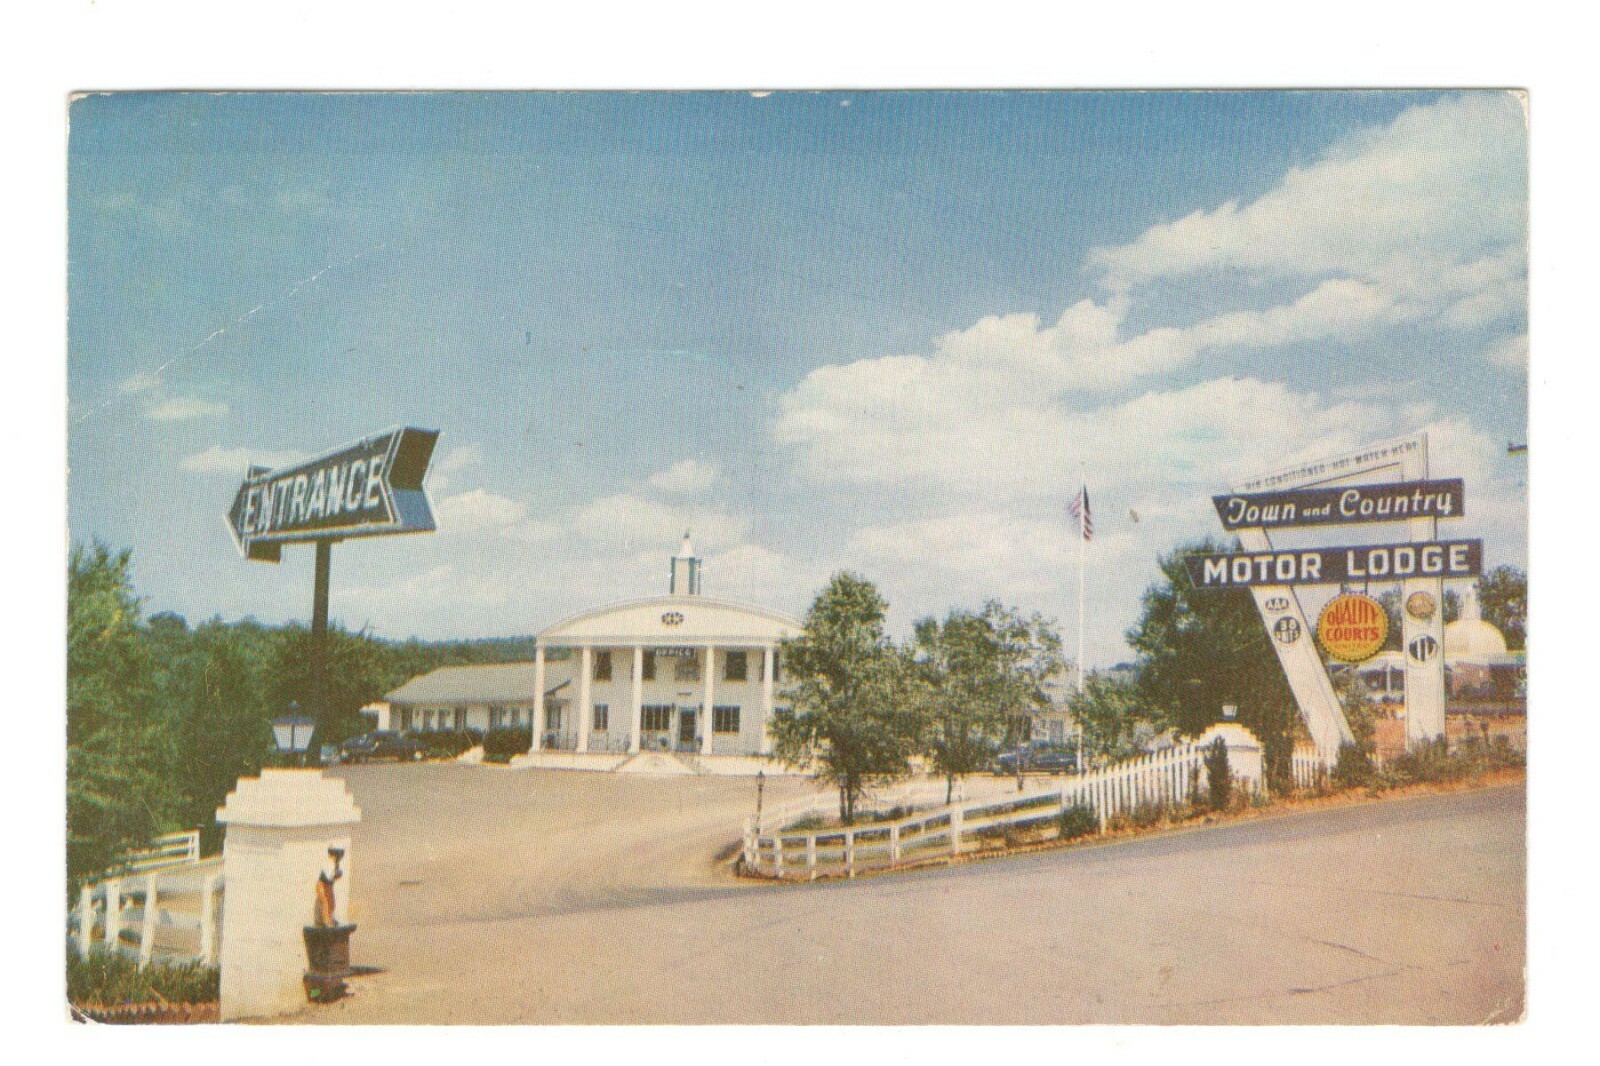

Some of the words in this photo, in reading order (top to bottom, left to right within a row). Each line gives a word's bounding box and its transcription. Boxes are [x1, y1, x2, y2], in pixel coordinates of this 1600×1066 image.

[1264, 464, 1326, 486] CONDITIONED
[242, 454, 385, 534] ENTRANCE
[1227, 498, 1296, 525] Town
[1302, 503, 1331, 517] and
[1339, 488, 1453, 517] Country
[1203, 552, 1323, 585] MOTOR
[1346, 544, 1471, 578] LODGE
[1326, 599, 1380, 627] QUALITY
[1324, 627, 1380, 643] COURTS
